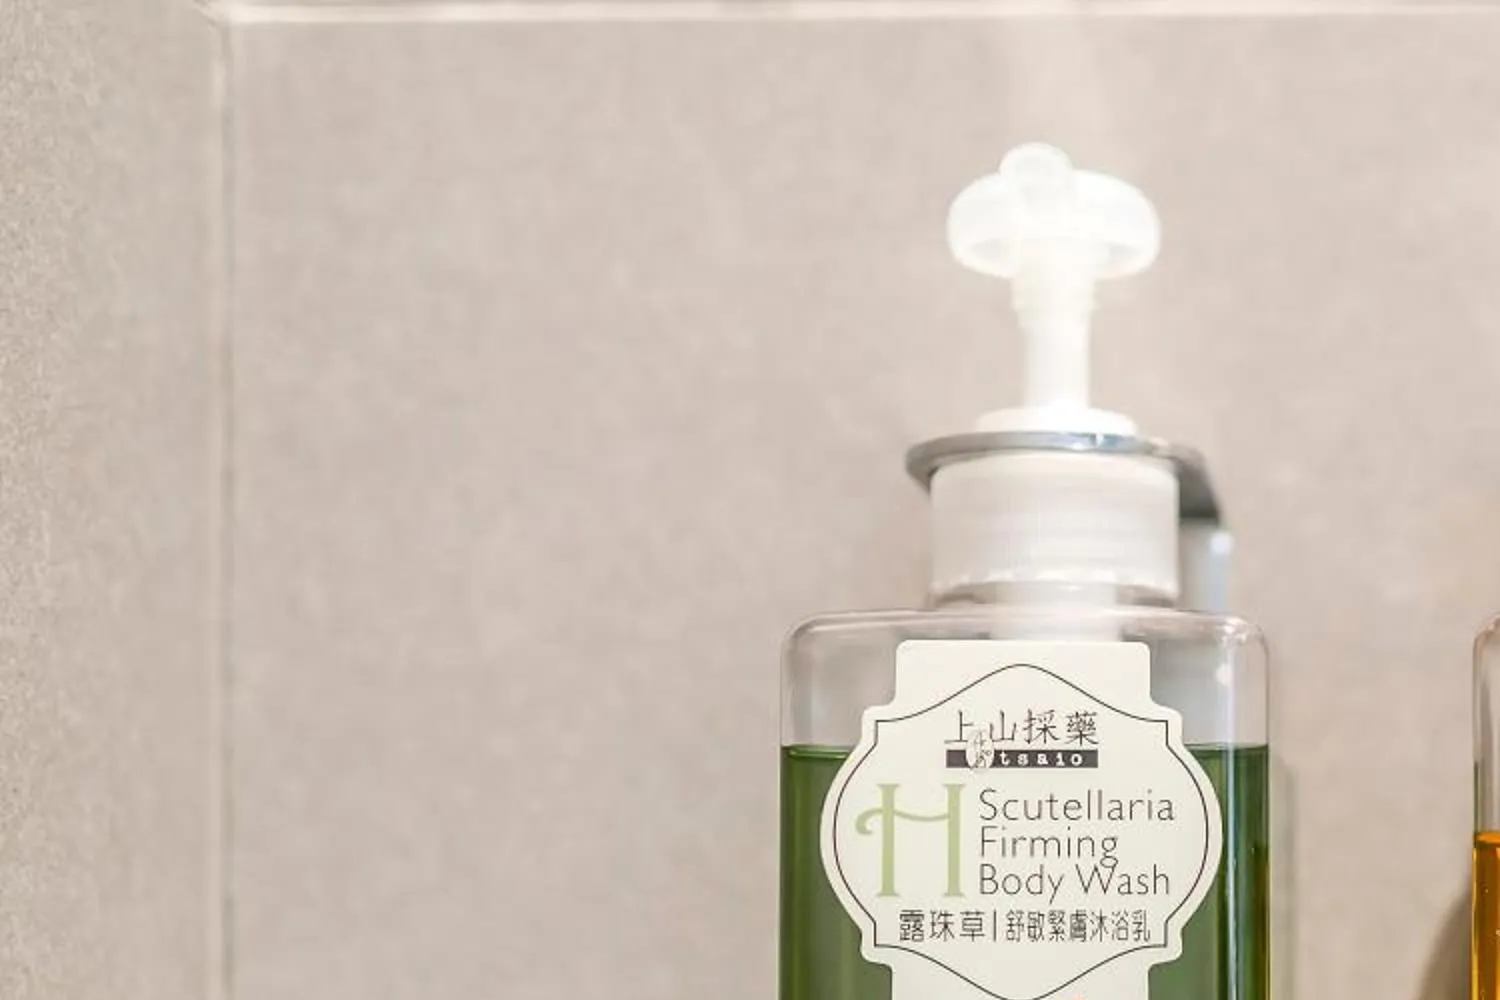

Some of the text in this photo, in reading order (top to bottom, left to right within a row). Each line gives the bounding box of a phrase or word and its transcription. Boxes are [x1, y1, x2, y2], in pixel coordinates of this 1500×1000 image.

[944, 709, 1099, 746] 上山採藥
[979, 788, 1175, 822] Scutellaria
[979, 826, 1119, 868] Firming
[979, 864, 1169, 904] Body Wash
